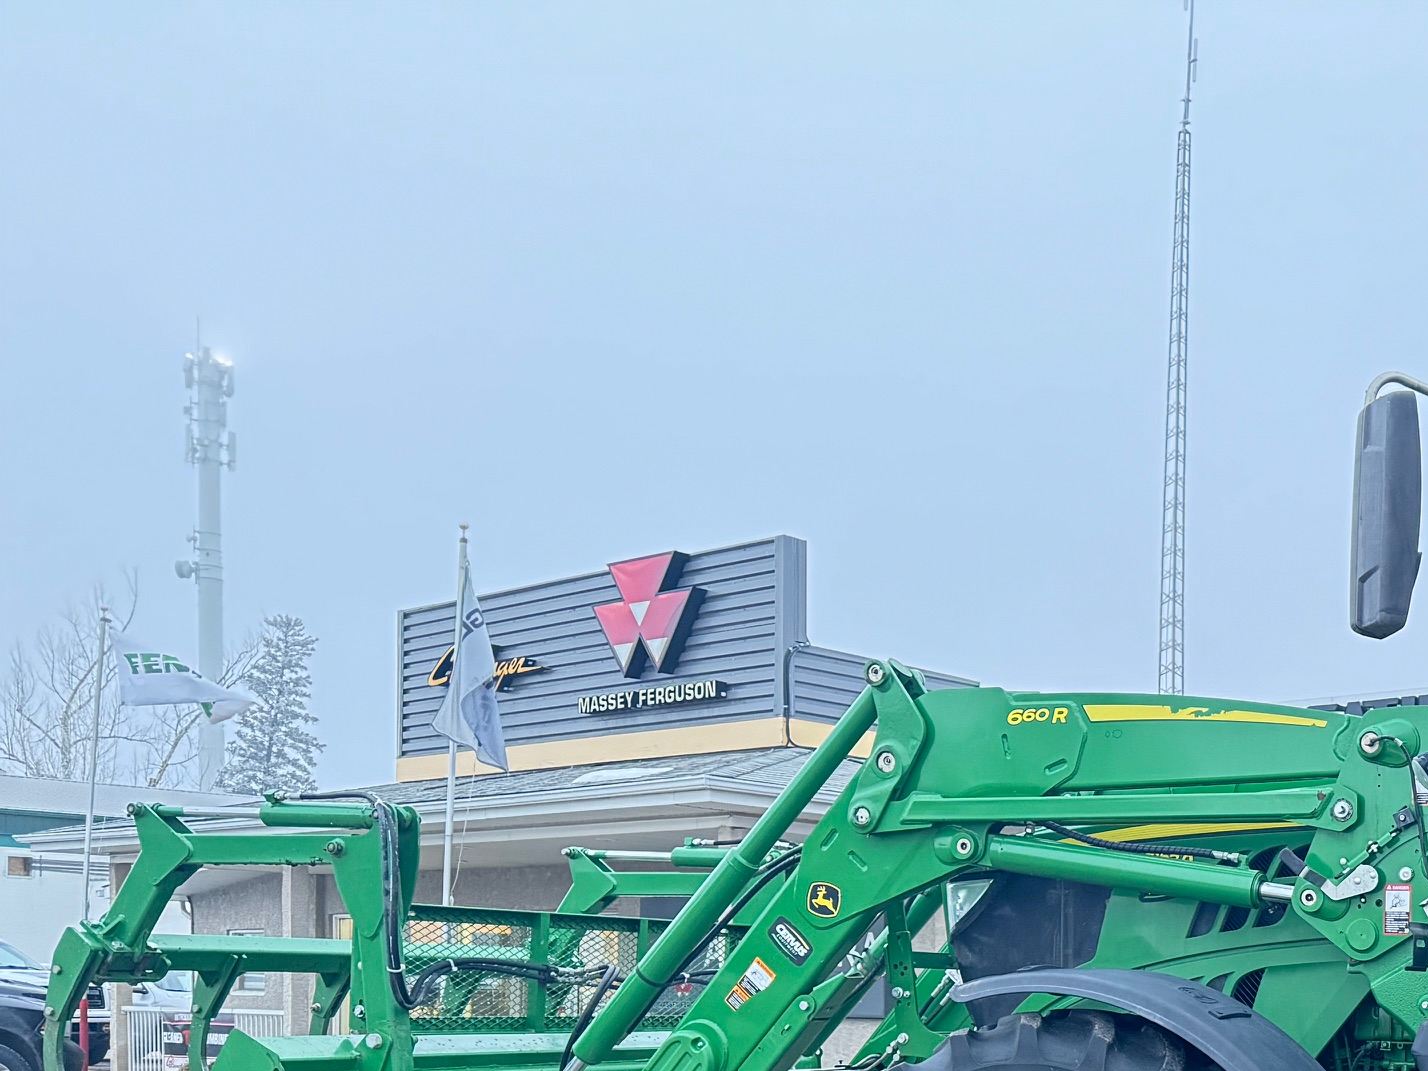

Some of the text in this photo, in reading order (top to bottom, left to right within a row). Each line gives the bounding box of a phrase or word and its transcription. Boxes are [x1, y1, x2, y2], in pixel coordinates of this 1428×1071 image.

[124, 653, 201, 678] FEN
[578, 680, 717, 714] MASSEY FERGUSON
[1007, 707, 1069, 726] 660 R
